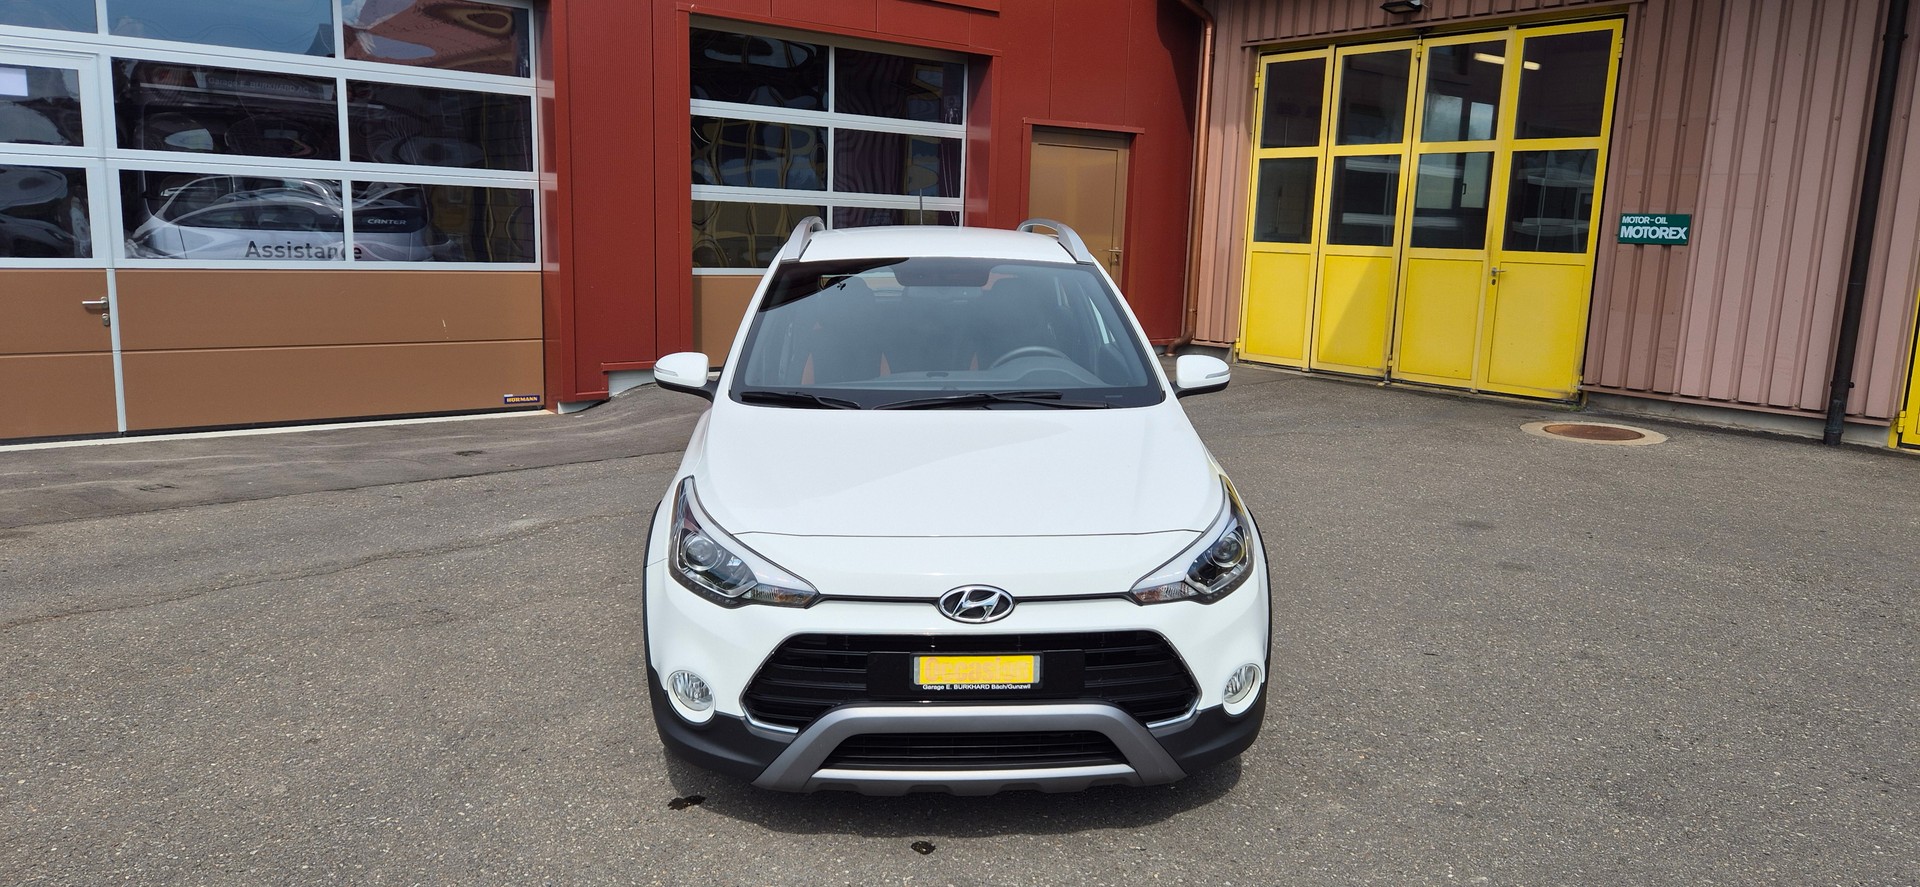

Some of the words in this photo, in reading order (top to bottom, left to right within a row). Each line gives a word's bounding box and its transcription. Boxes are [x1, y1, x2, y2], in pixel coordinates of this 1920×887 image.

[250, 81, 295, 92] BURKHARD
[1622, 215, 1668, 225] MOTOR-OIL
[1620, 225, 1688, 240] MOTOREX
[924, 656, 1030, 682] Occasion
